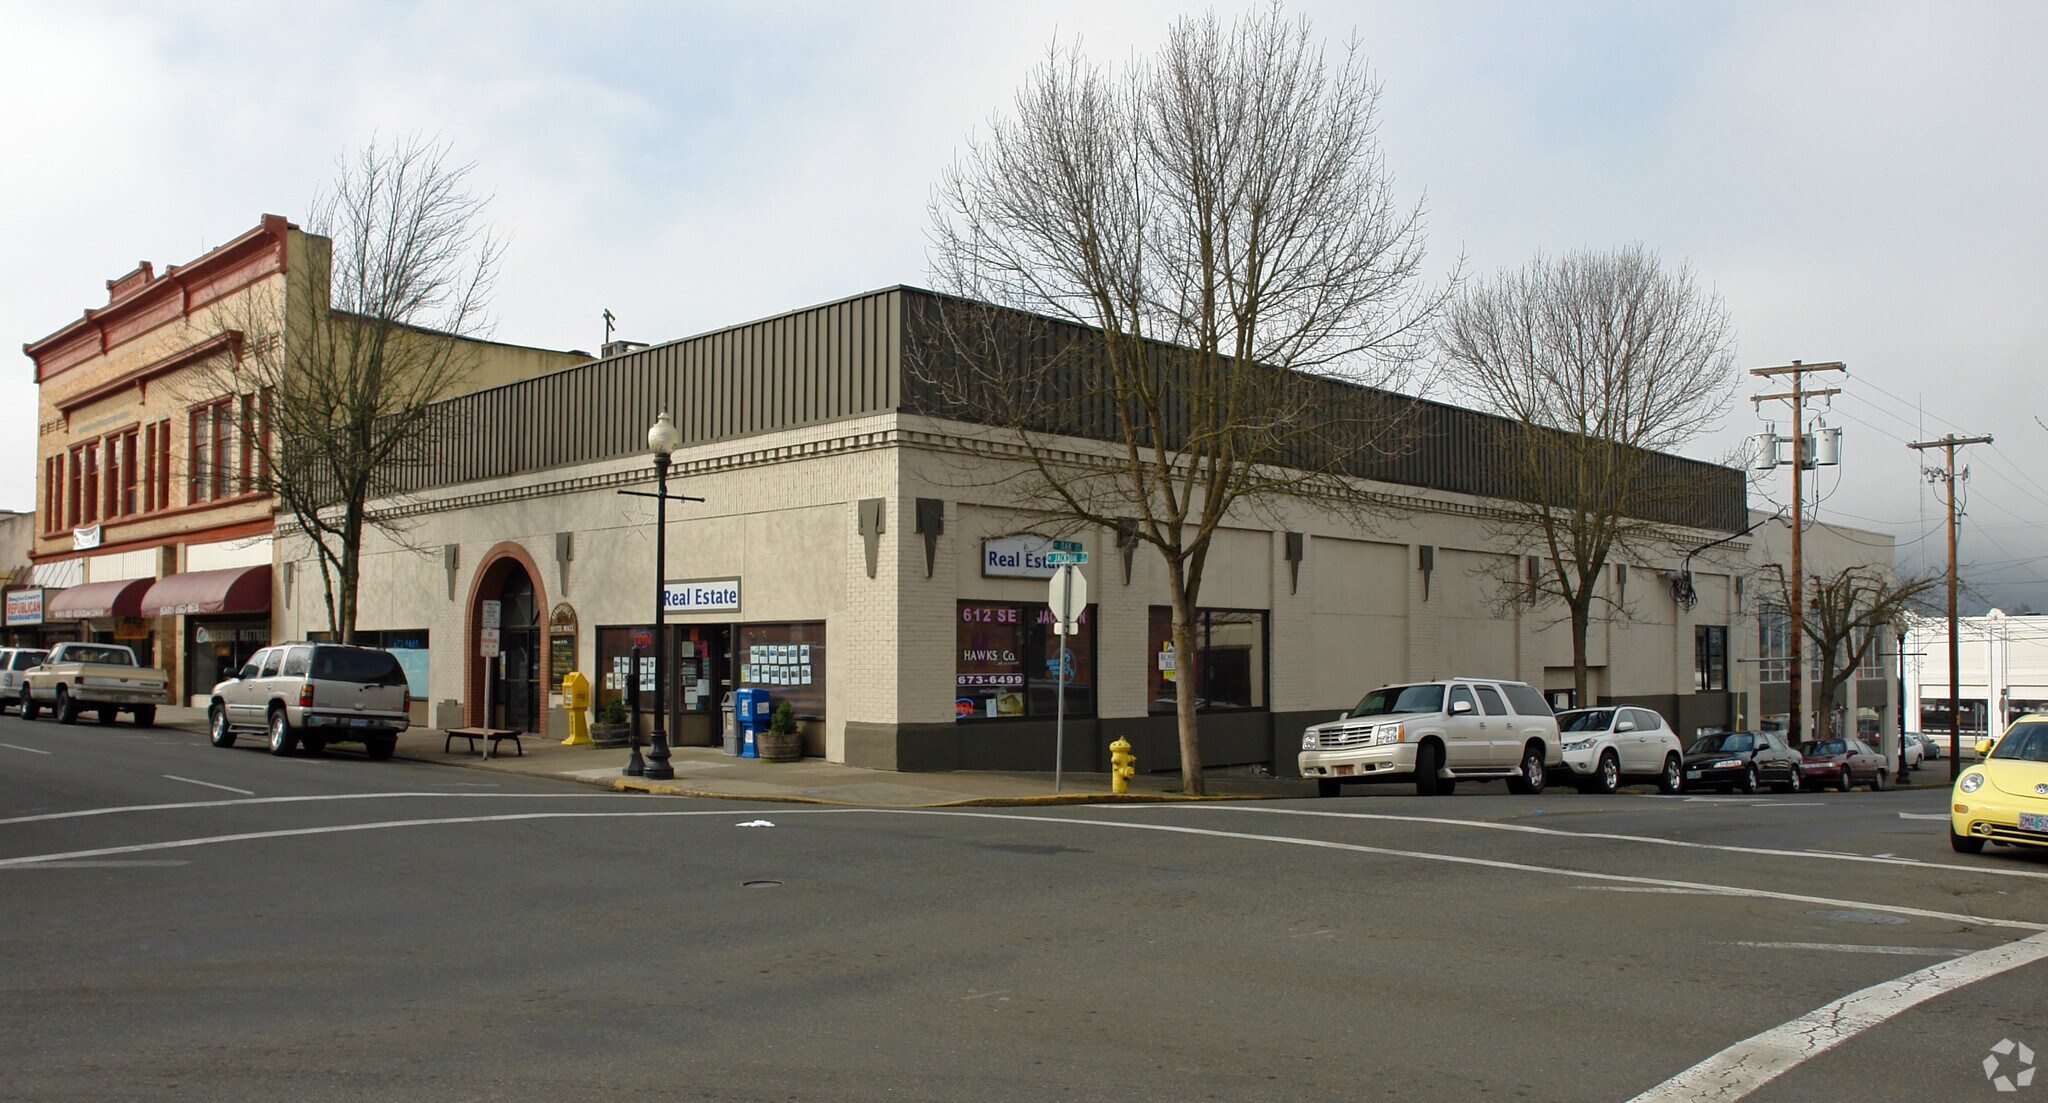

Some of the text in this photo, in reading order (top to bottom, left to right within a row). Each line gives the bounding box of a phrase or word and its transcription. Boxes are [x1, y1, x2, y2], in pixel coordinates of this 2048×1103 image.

[989, 551, 1020, 567] Real
[1054, 553, 1078, 562] JACKSON
[663, 588, 737, 606] Real Estate
[8, 601, 40, 614] REPUBLICAN
[963, 608, 1016, 622] 612 SE
[1037, 610, 1086, 624] JACN
[964, 650, 998, 661] HAWKS
[958, 676, 1022, 684] 673-6499
